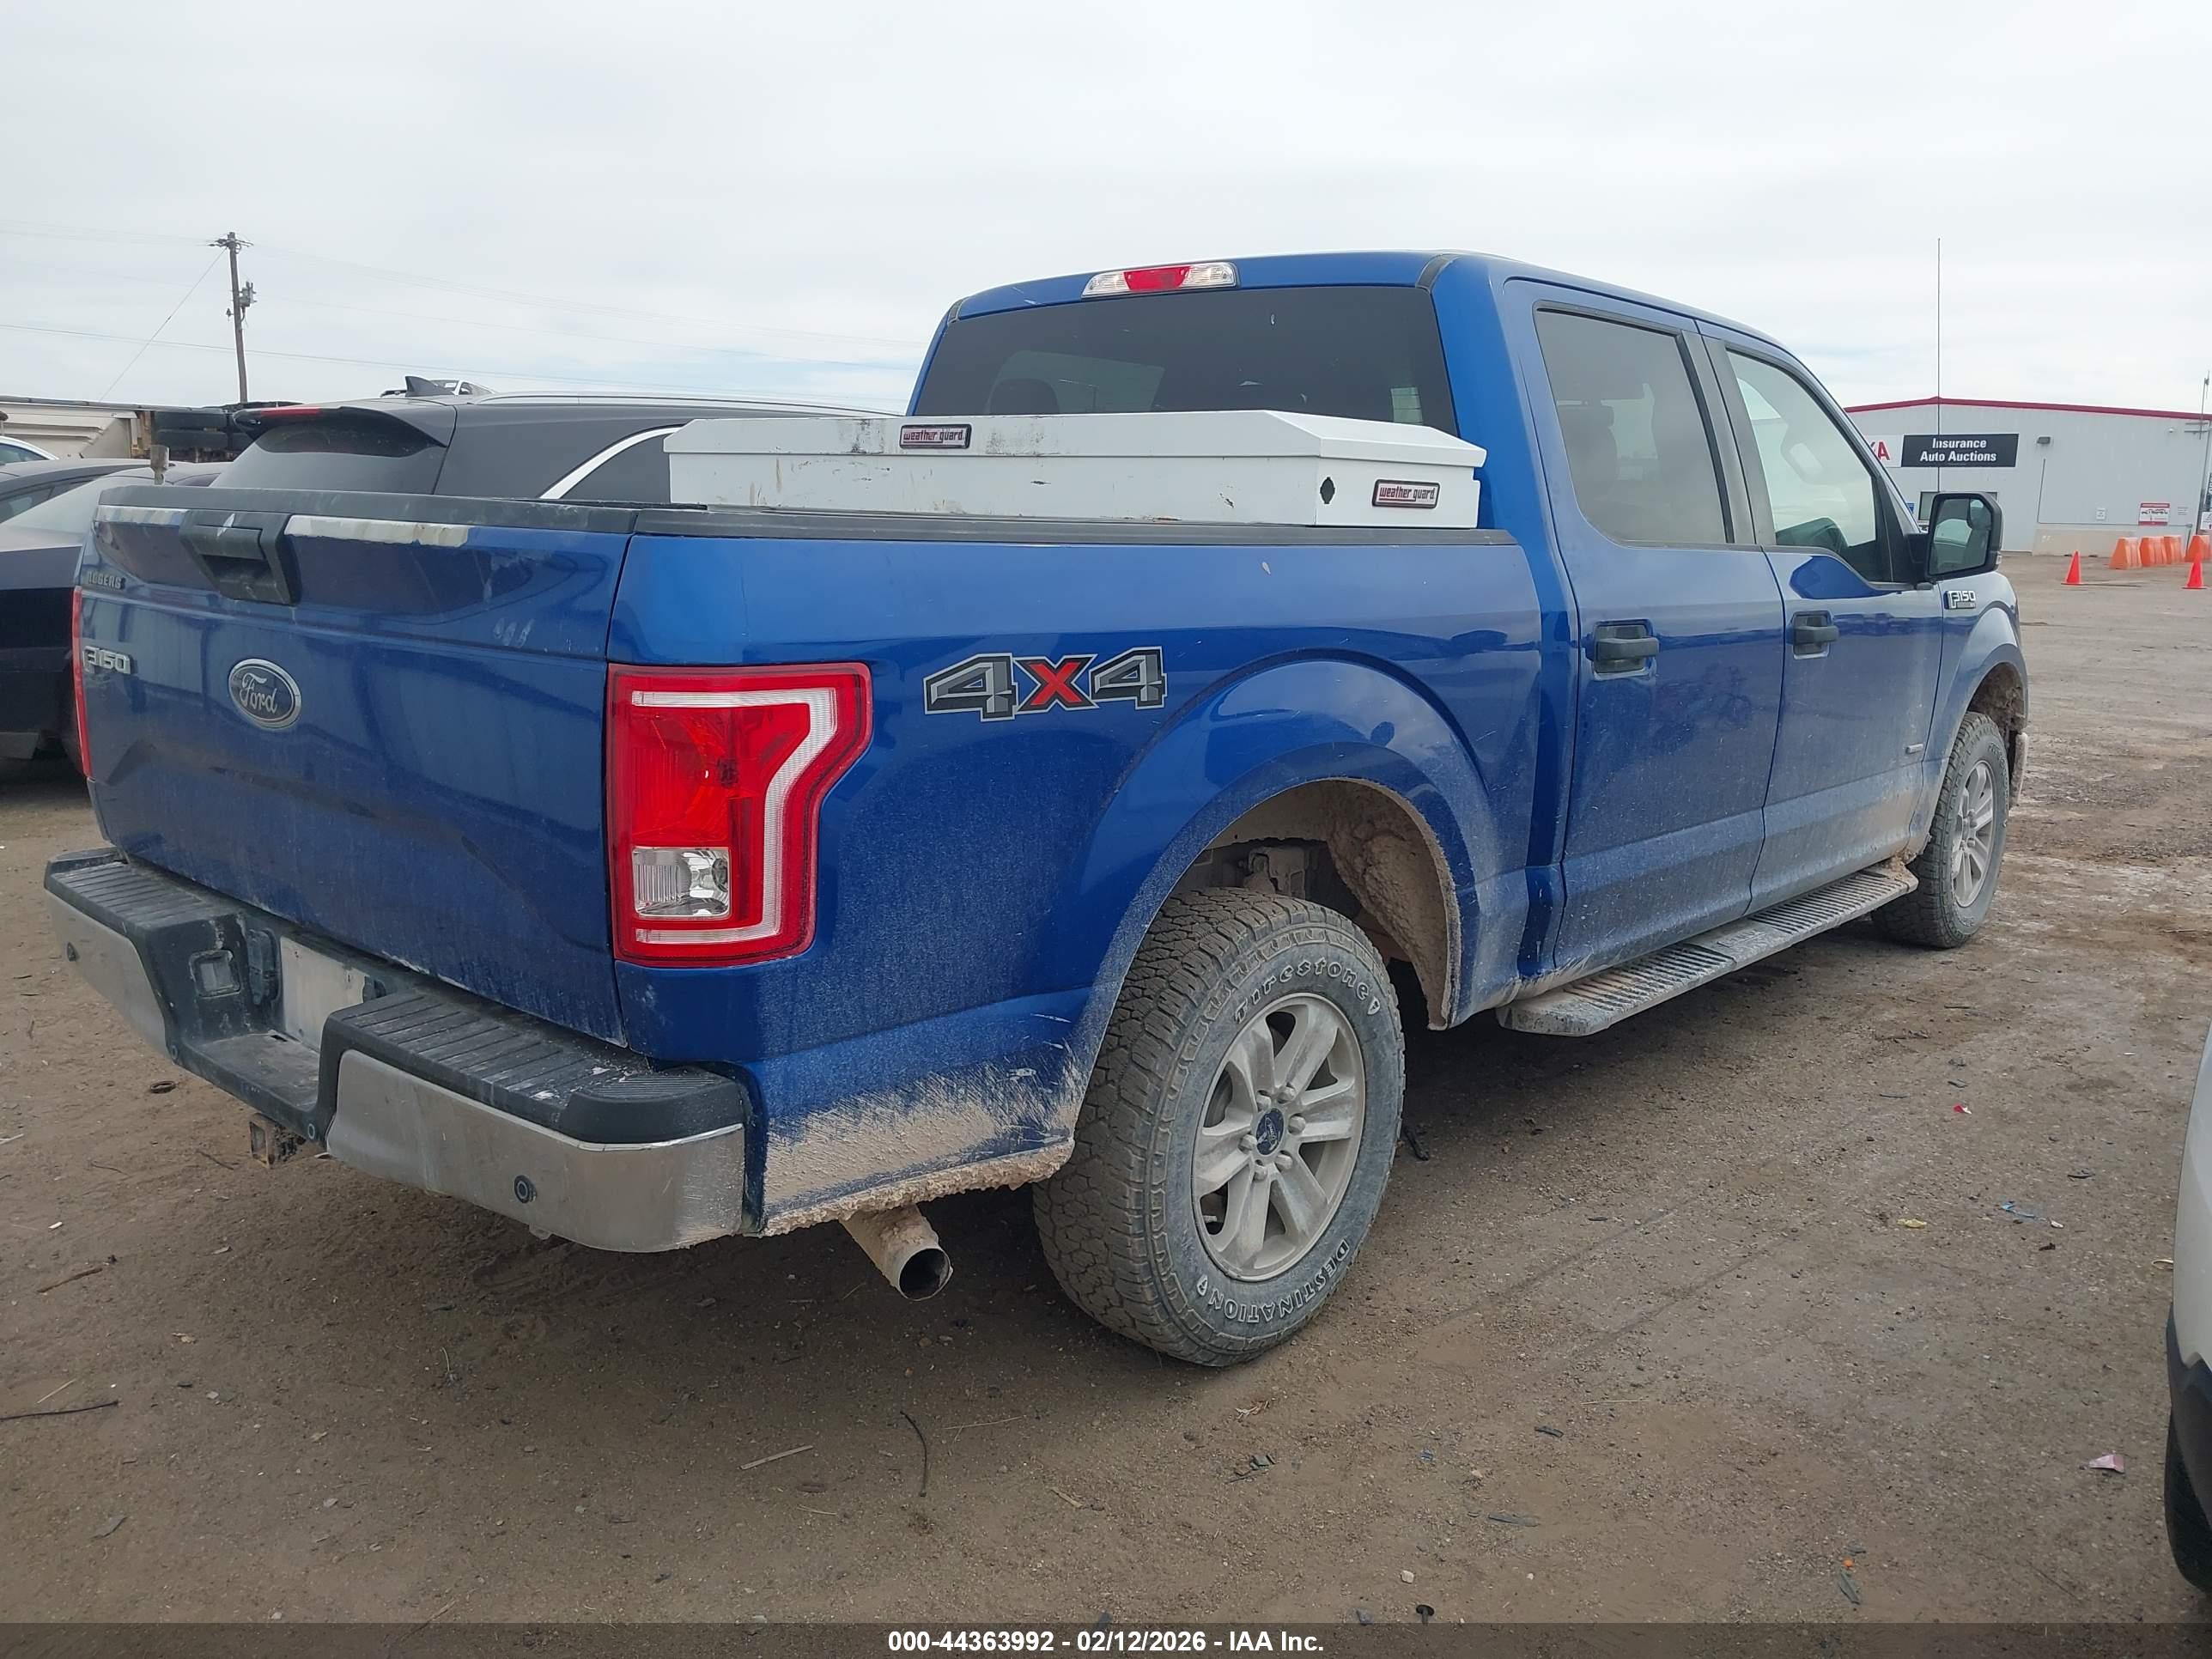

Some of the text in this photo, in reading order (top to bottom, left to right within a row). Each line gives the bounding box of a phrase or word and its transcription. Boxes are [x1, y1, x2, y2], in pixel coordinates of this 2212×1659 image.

[903, 429, 963, 443] weather guard
[1932, 438, 1986, 449] Insurance
[1919, 451, 1997, 462] Auto Auctions
[1379, 485, 1435, 501] weather guard
[240, 672, 278, 714] Ford
[1208, 1238, 1349, 1323] DESTINATION
